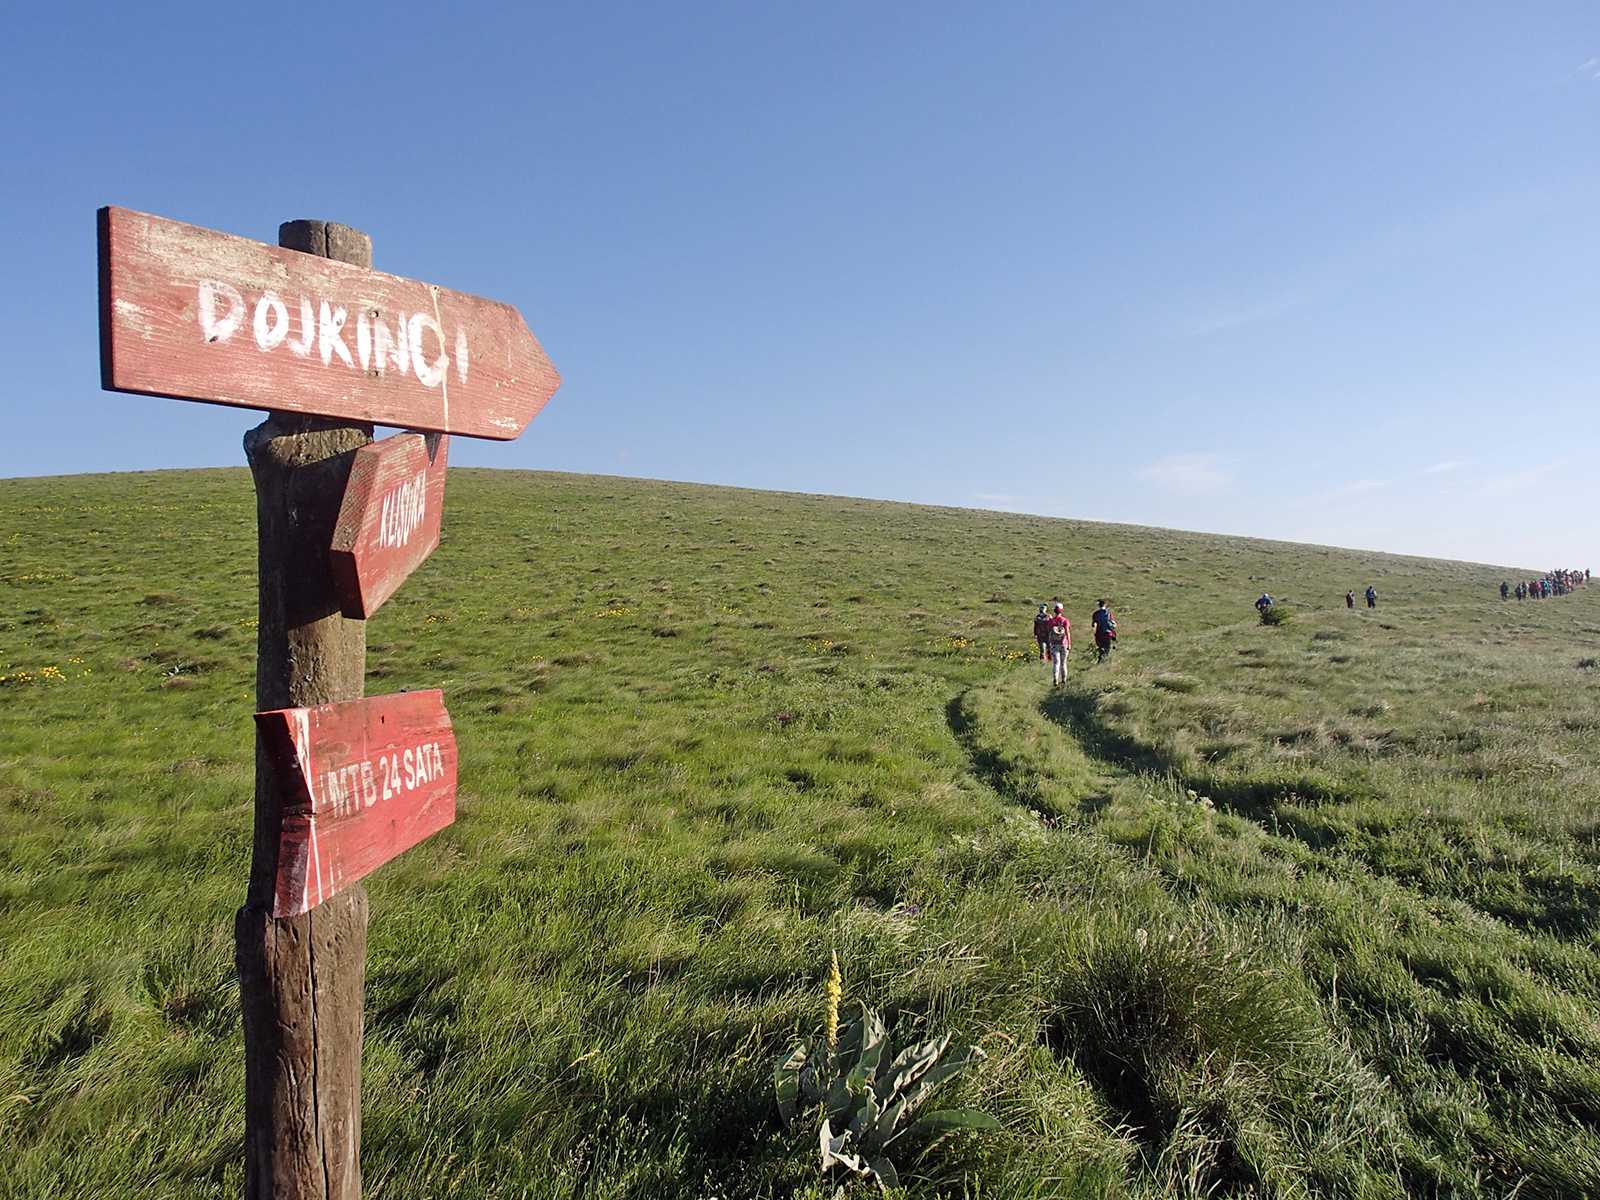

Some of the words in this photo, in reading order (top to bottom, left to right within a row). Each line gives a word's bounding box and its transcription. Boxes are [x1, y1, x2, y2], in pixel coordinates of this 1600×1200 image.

[197, 278, 469, 386] DOJKINCI
[380, 753, 402, 801] 24
[403, 742, 444, 790] SATA
